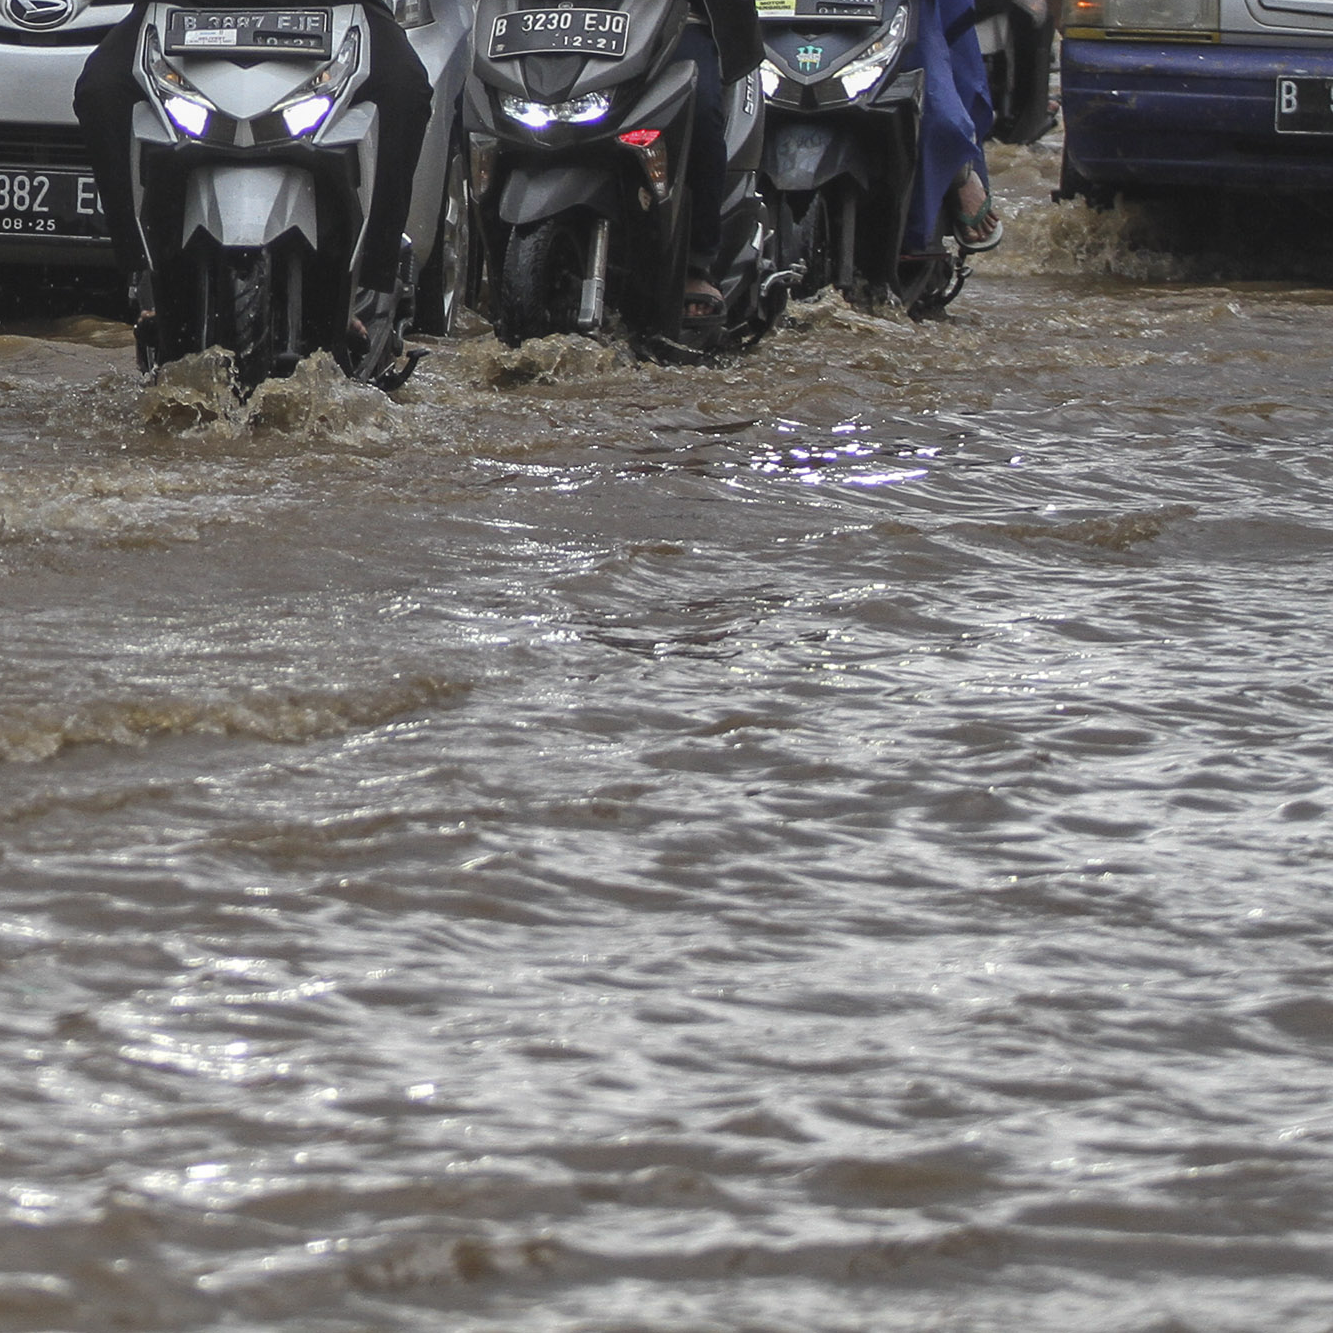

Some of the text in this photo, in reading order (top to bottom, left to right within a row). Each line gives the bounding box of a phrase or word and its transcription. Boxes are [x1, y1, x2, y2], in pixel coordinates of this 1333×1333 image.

[184, 16, 197, 30] B
[495, 18, 508, 37] B
[521, 12, 573, 32] 3230
[1280, 80, 1298, 114] B
